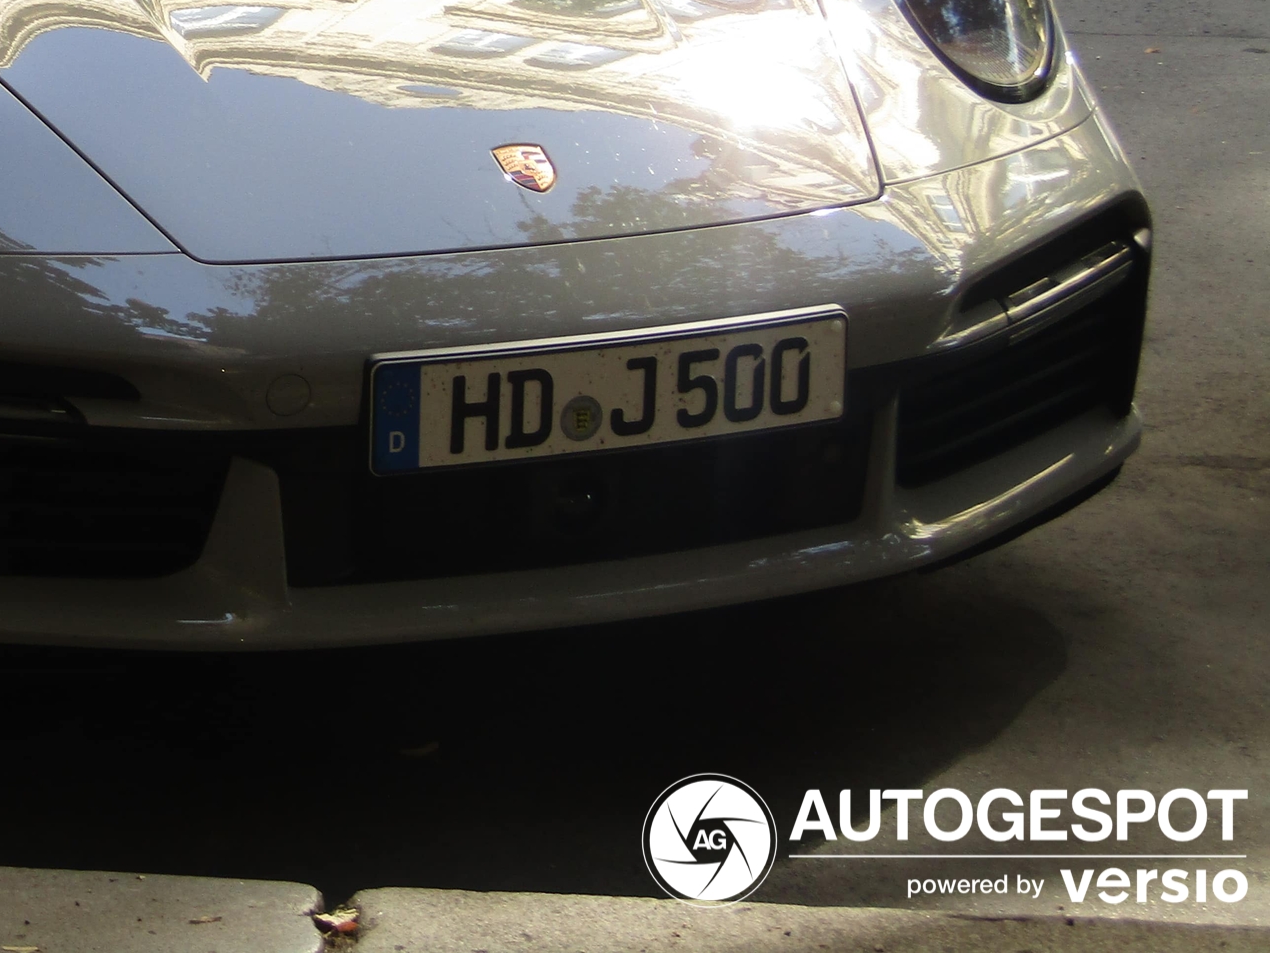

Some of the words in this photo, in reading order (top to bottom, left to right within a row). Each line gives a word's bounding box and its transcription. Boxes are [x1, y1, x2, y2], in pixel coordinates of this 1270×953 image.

[449, 368, 553, 455] HD
[610, 356, 658, 437] J
[676, 337, 811, 429] 500
[389, 430, 405, 453] D
